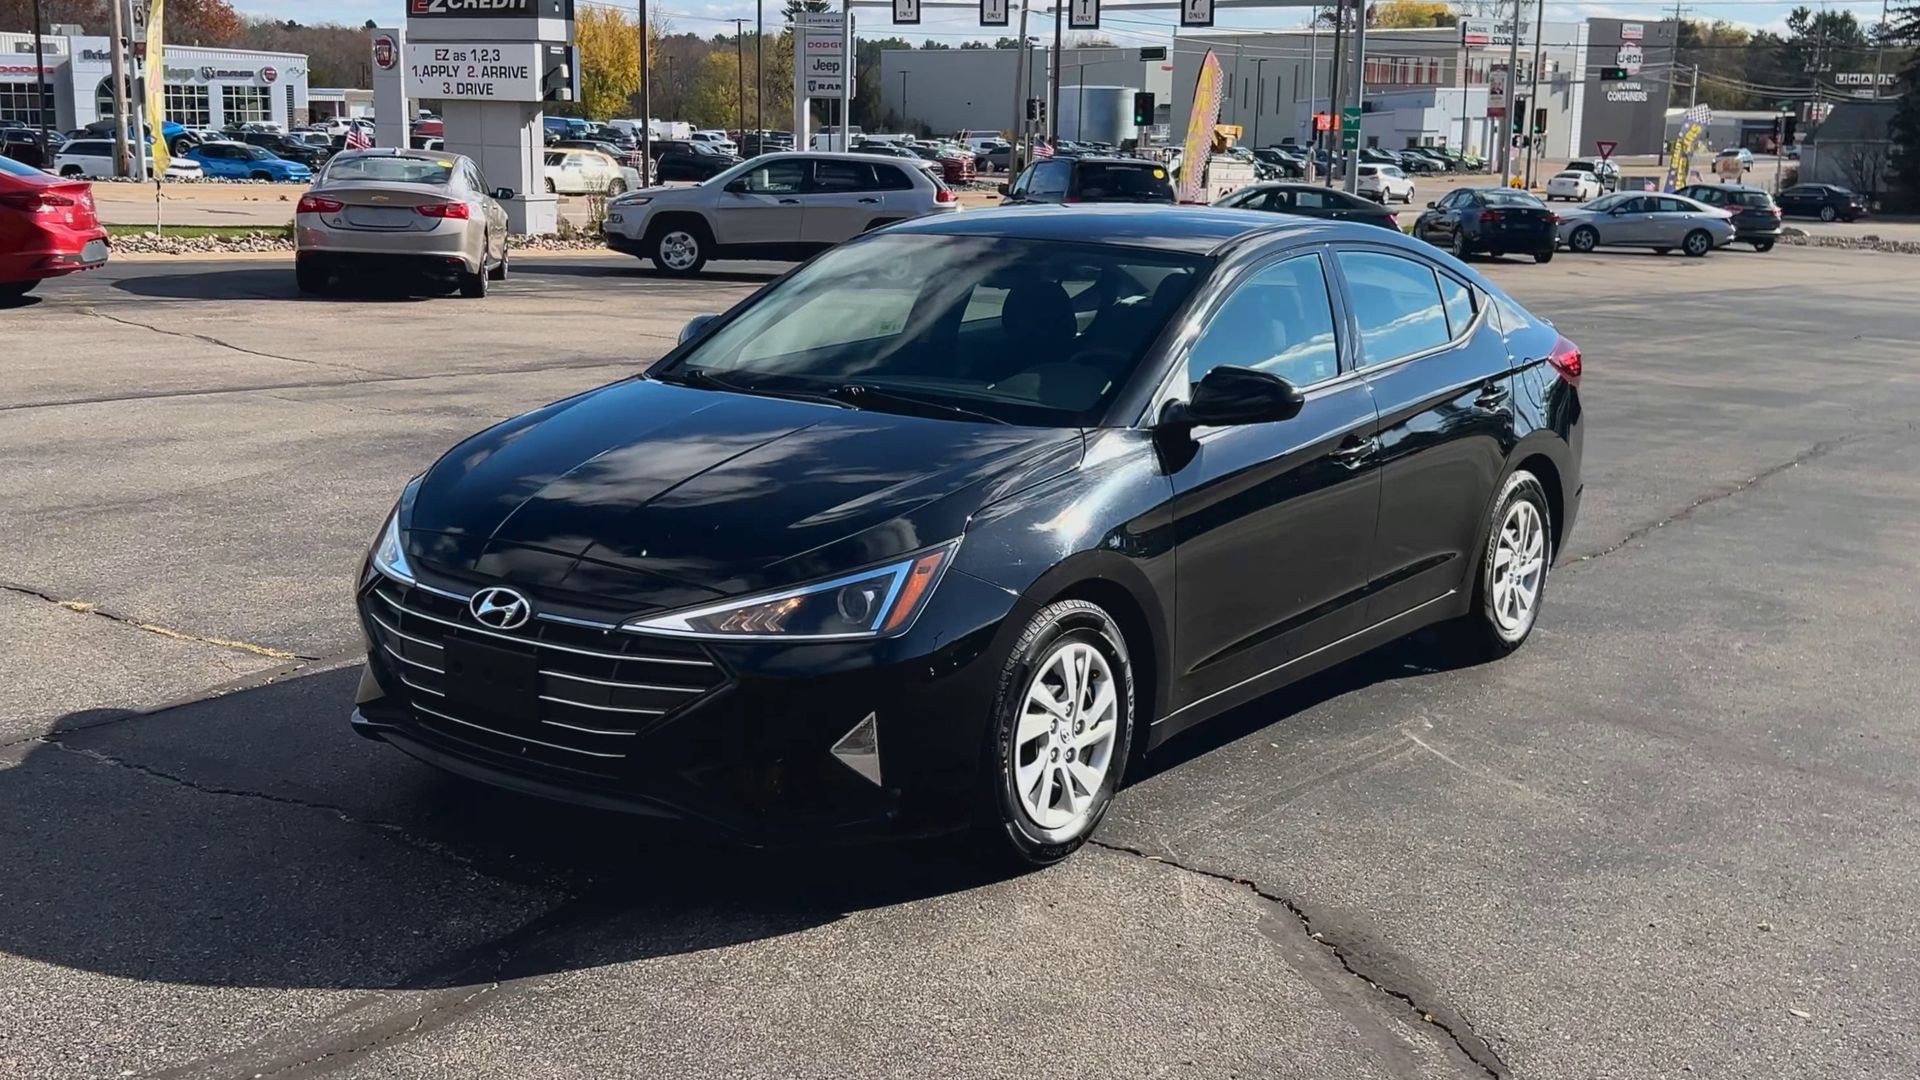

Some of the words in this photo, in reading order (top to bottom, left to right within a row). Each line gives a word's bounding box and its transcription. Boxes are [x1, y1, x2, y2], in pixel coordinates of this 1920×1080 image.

[435, 49, 449, 61] EZ
[453, 52, 466, 61] as
[470, 50, 500, 63] 1,2,3
[812, 58, 840, 73] Jeep
[467, 66, 479, 78] 2.
[481, 66, 528, 79] ARRIVE
[442, 82, 454, 94] 3.
[456, 83, 494, 95] DRIVE
[1607, 91, 1648, 102] CONTAINERS
